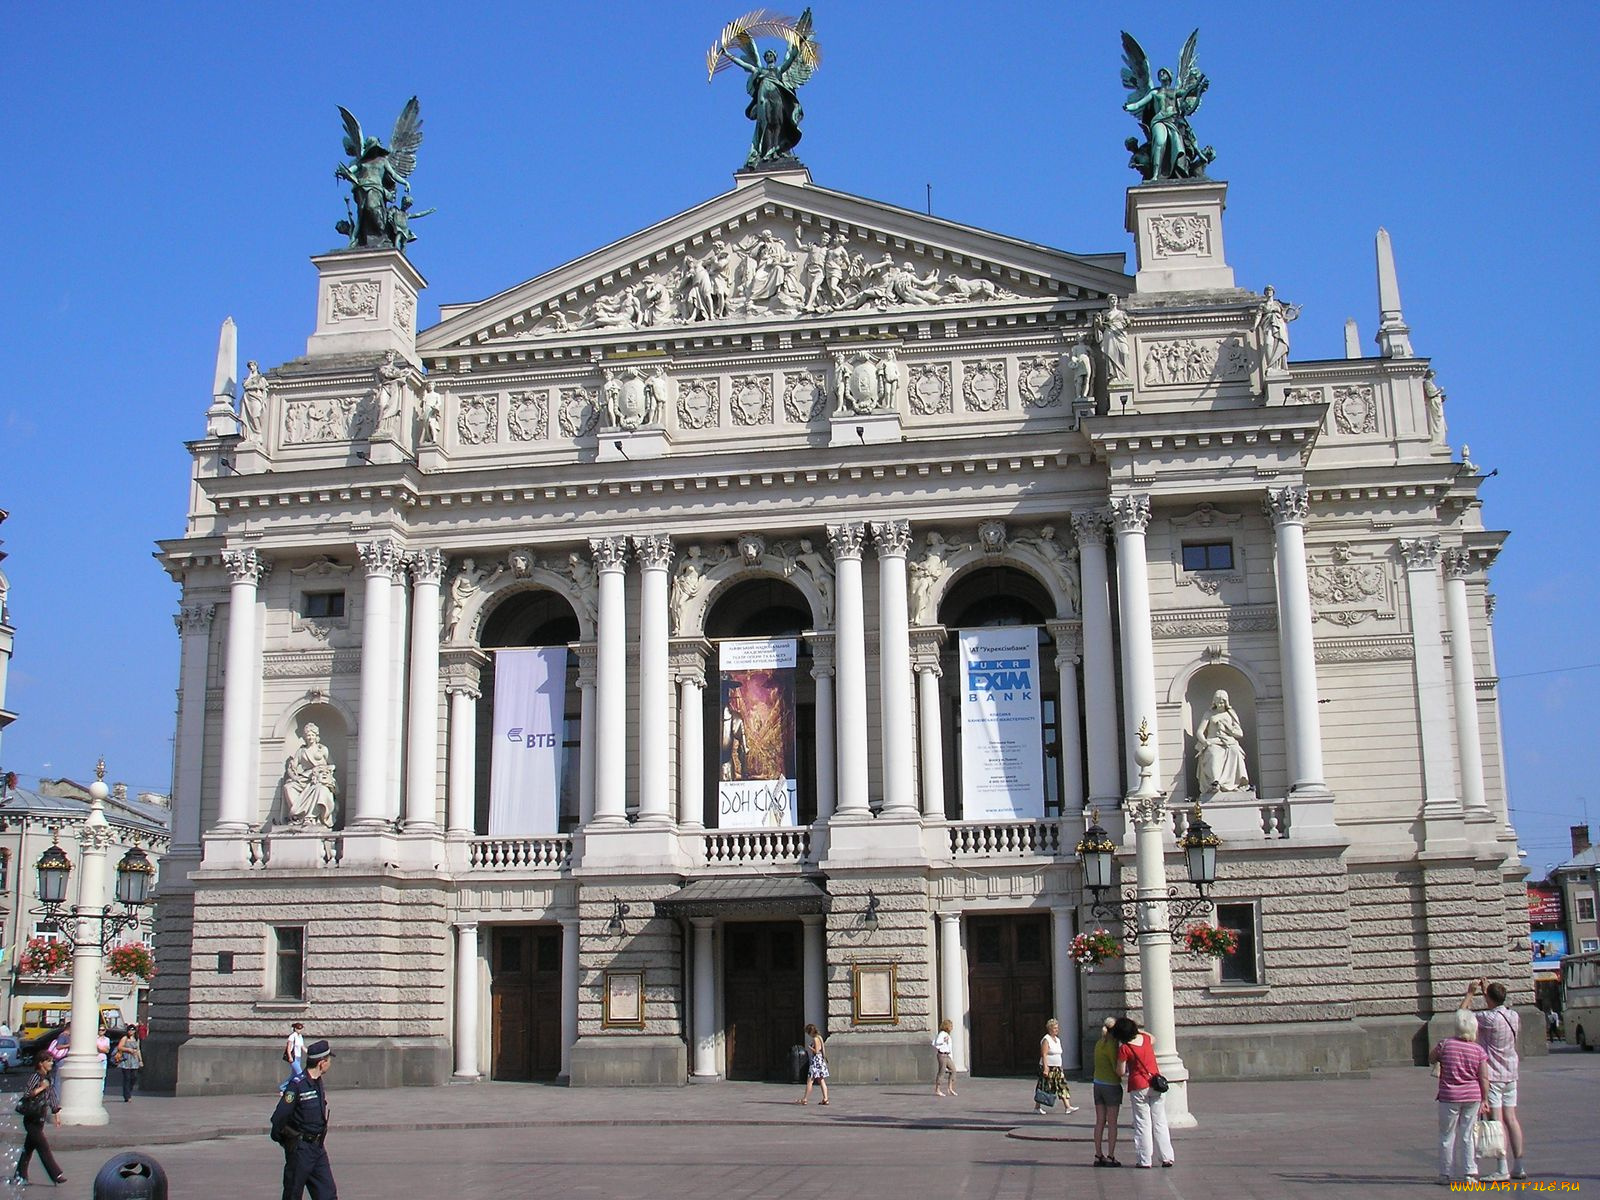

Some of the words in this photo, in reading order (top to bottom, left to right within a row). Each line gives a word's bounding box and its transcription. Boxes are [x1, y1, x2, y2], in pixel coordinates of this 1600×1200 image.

[980, 660, 1020, 669] UKR
[968, 671, 1031, 691] EXIM
[969, 692, 1032, 702] BANK
[527, 733, 556, 748] ВТБ
[721, 790, 749, 815] ДОН
[754, 788, 796, 812] КІХОТ
